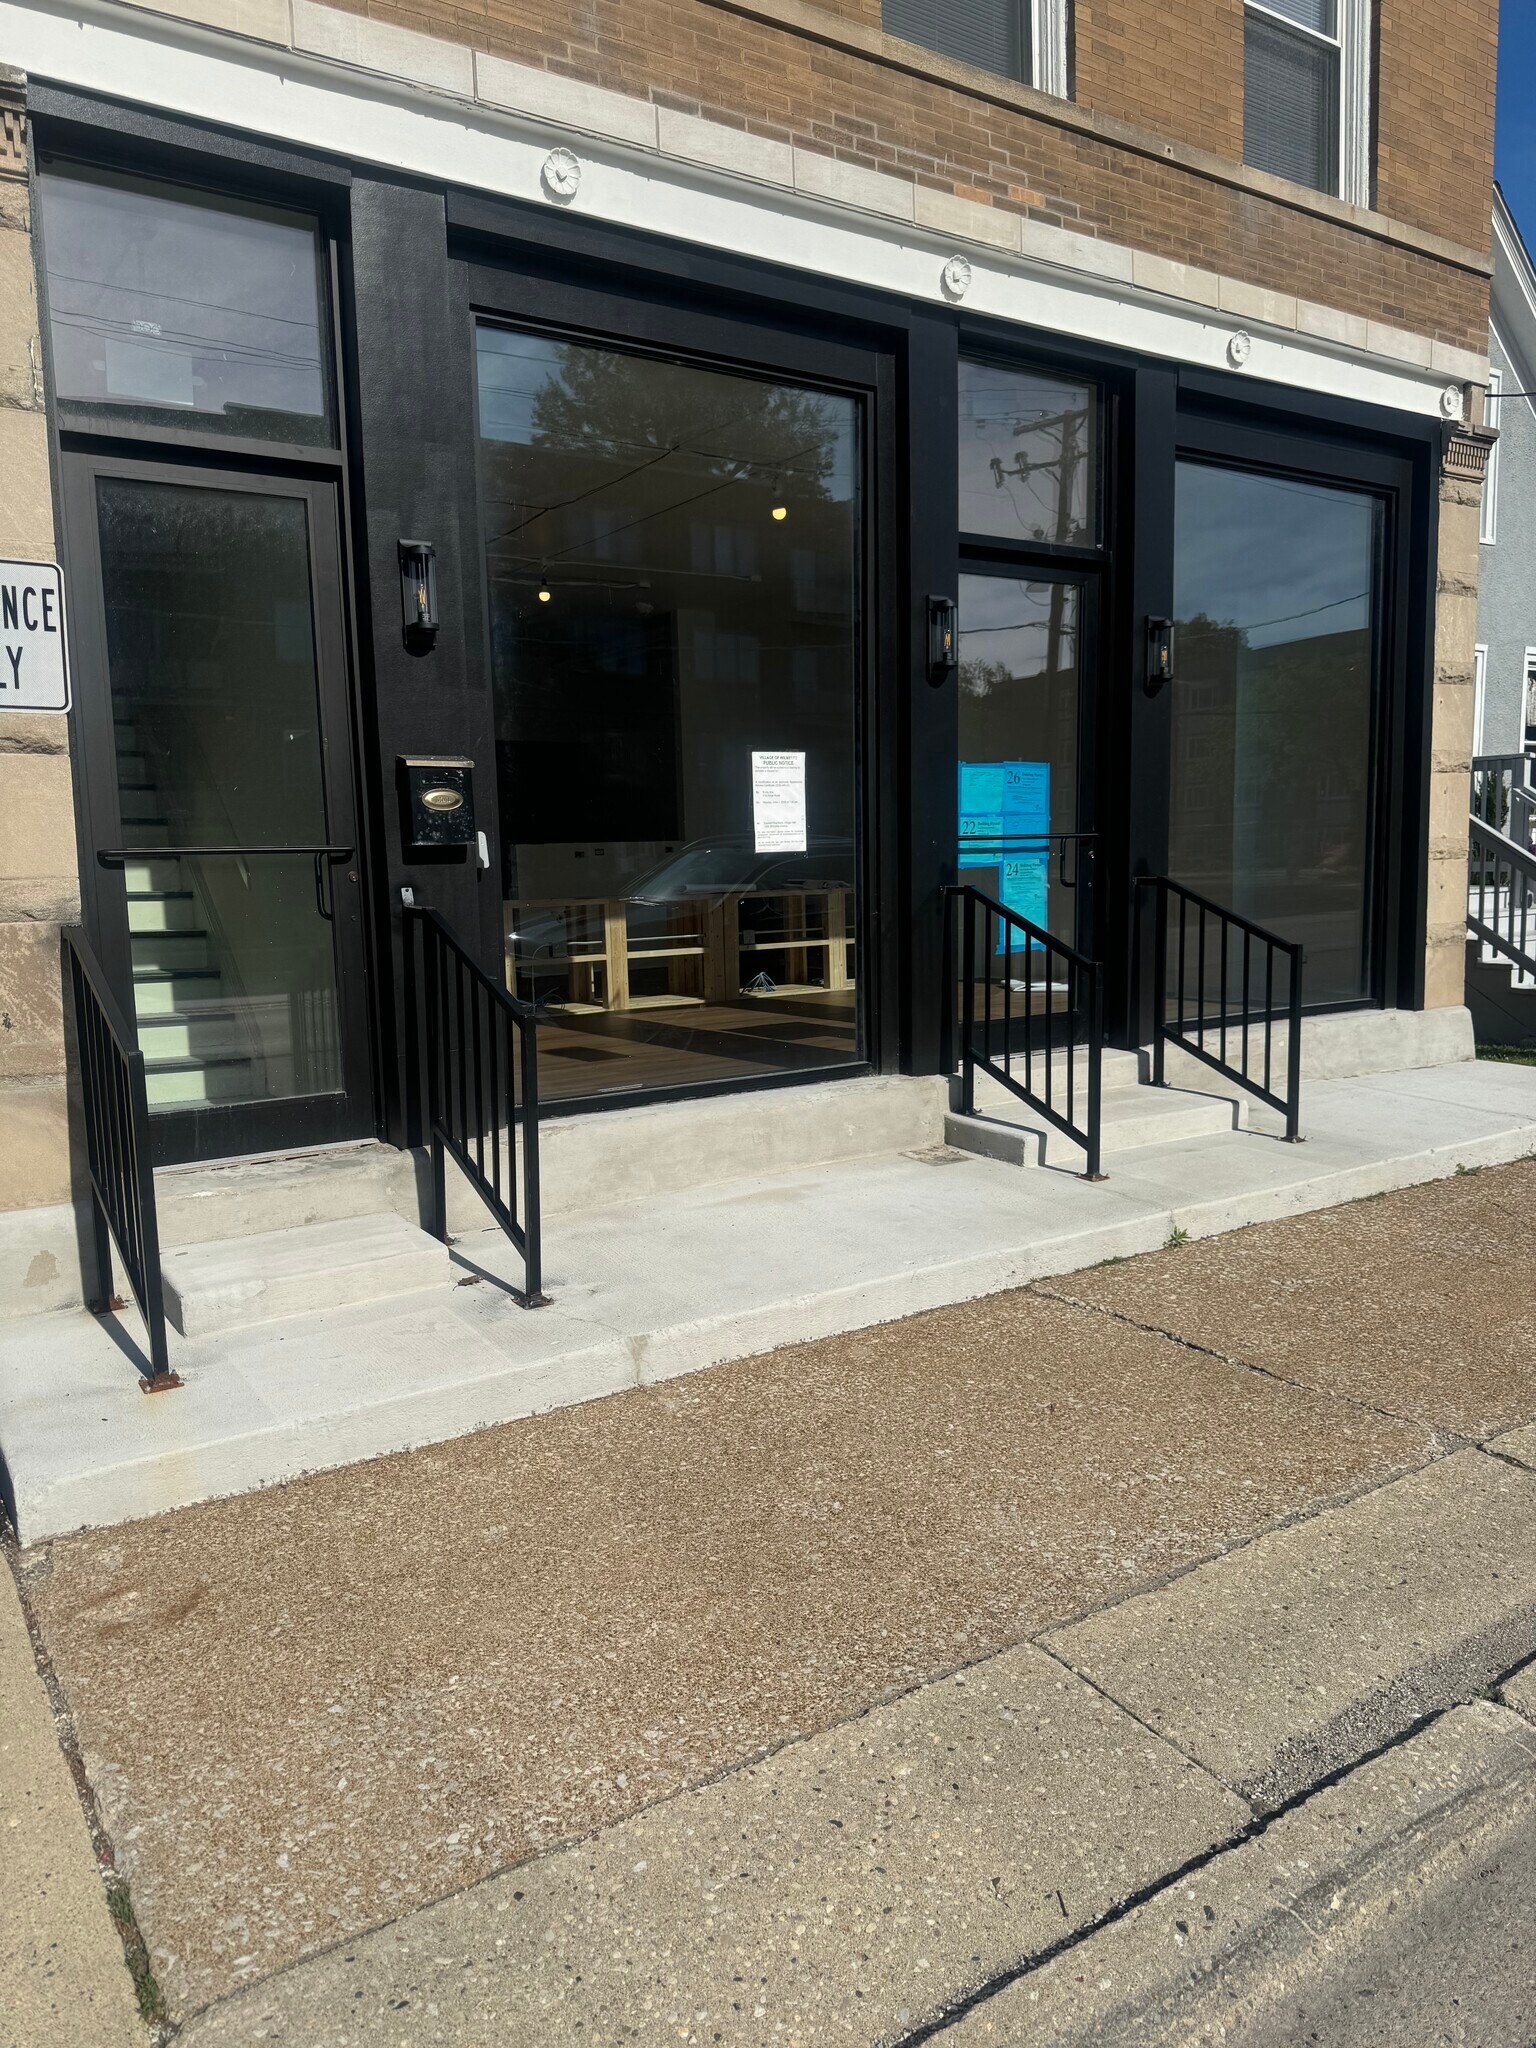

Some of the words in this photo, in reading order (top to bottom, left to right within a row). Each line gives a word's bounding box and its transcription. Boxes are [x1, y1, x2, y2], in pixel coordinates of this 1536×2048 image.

[1, 584, 57, 633] NCE
[1006, 770, 1021, 785] 26
[962, 820, 977, 835] 22
[1006, 863, 1019, 877] 24
